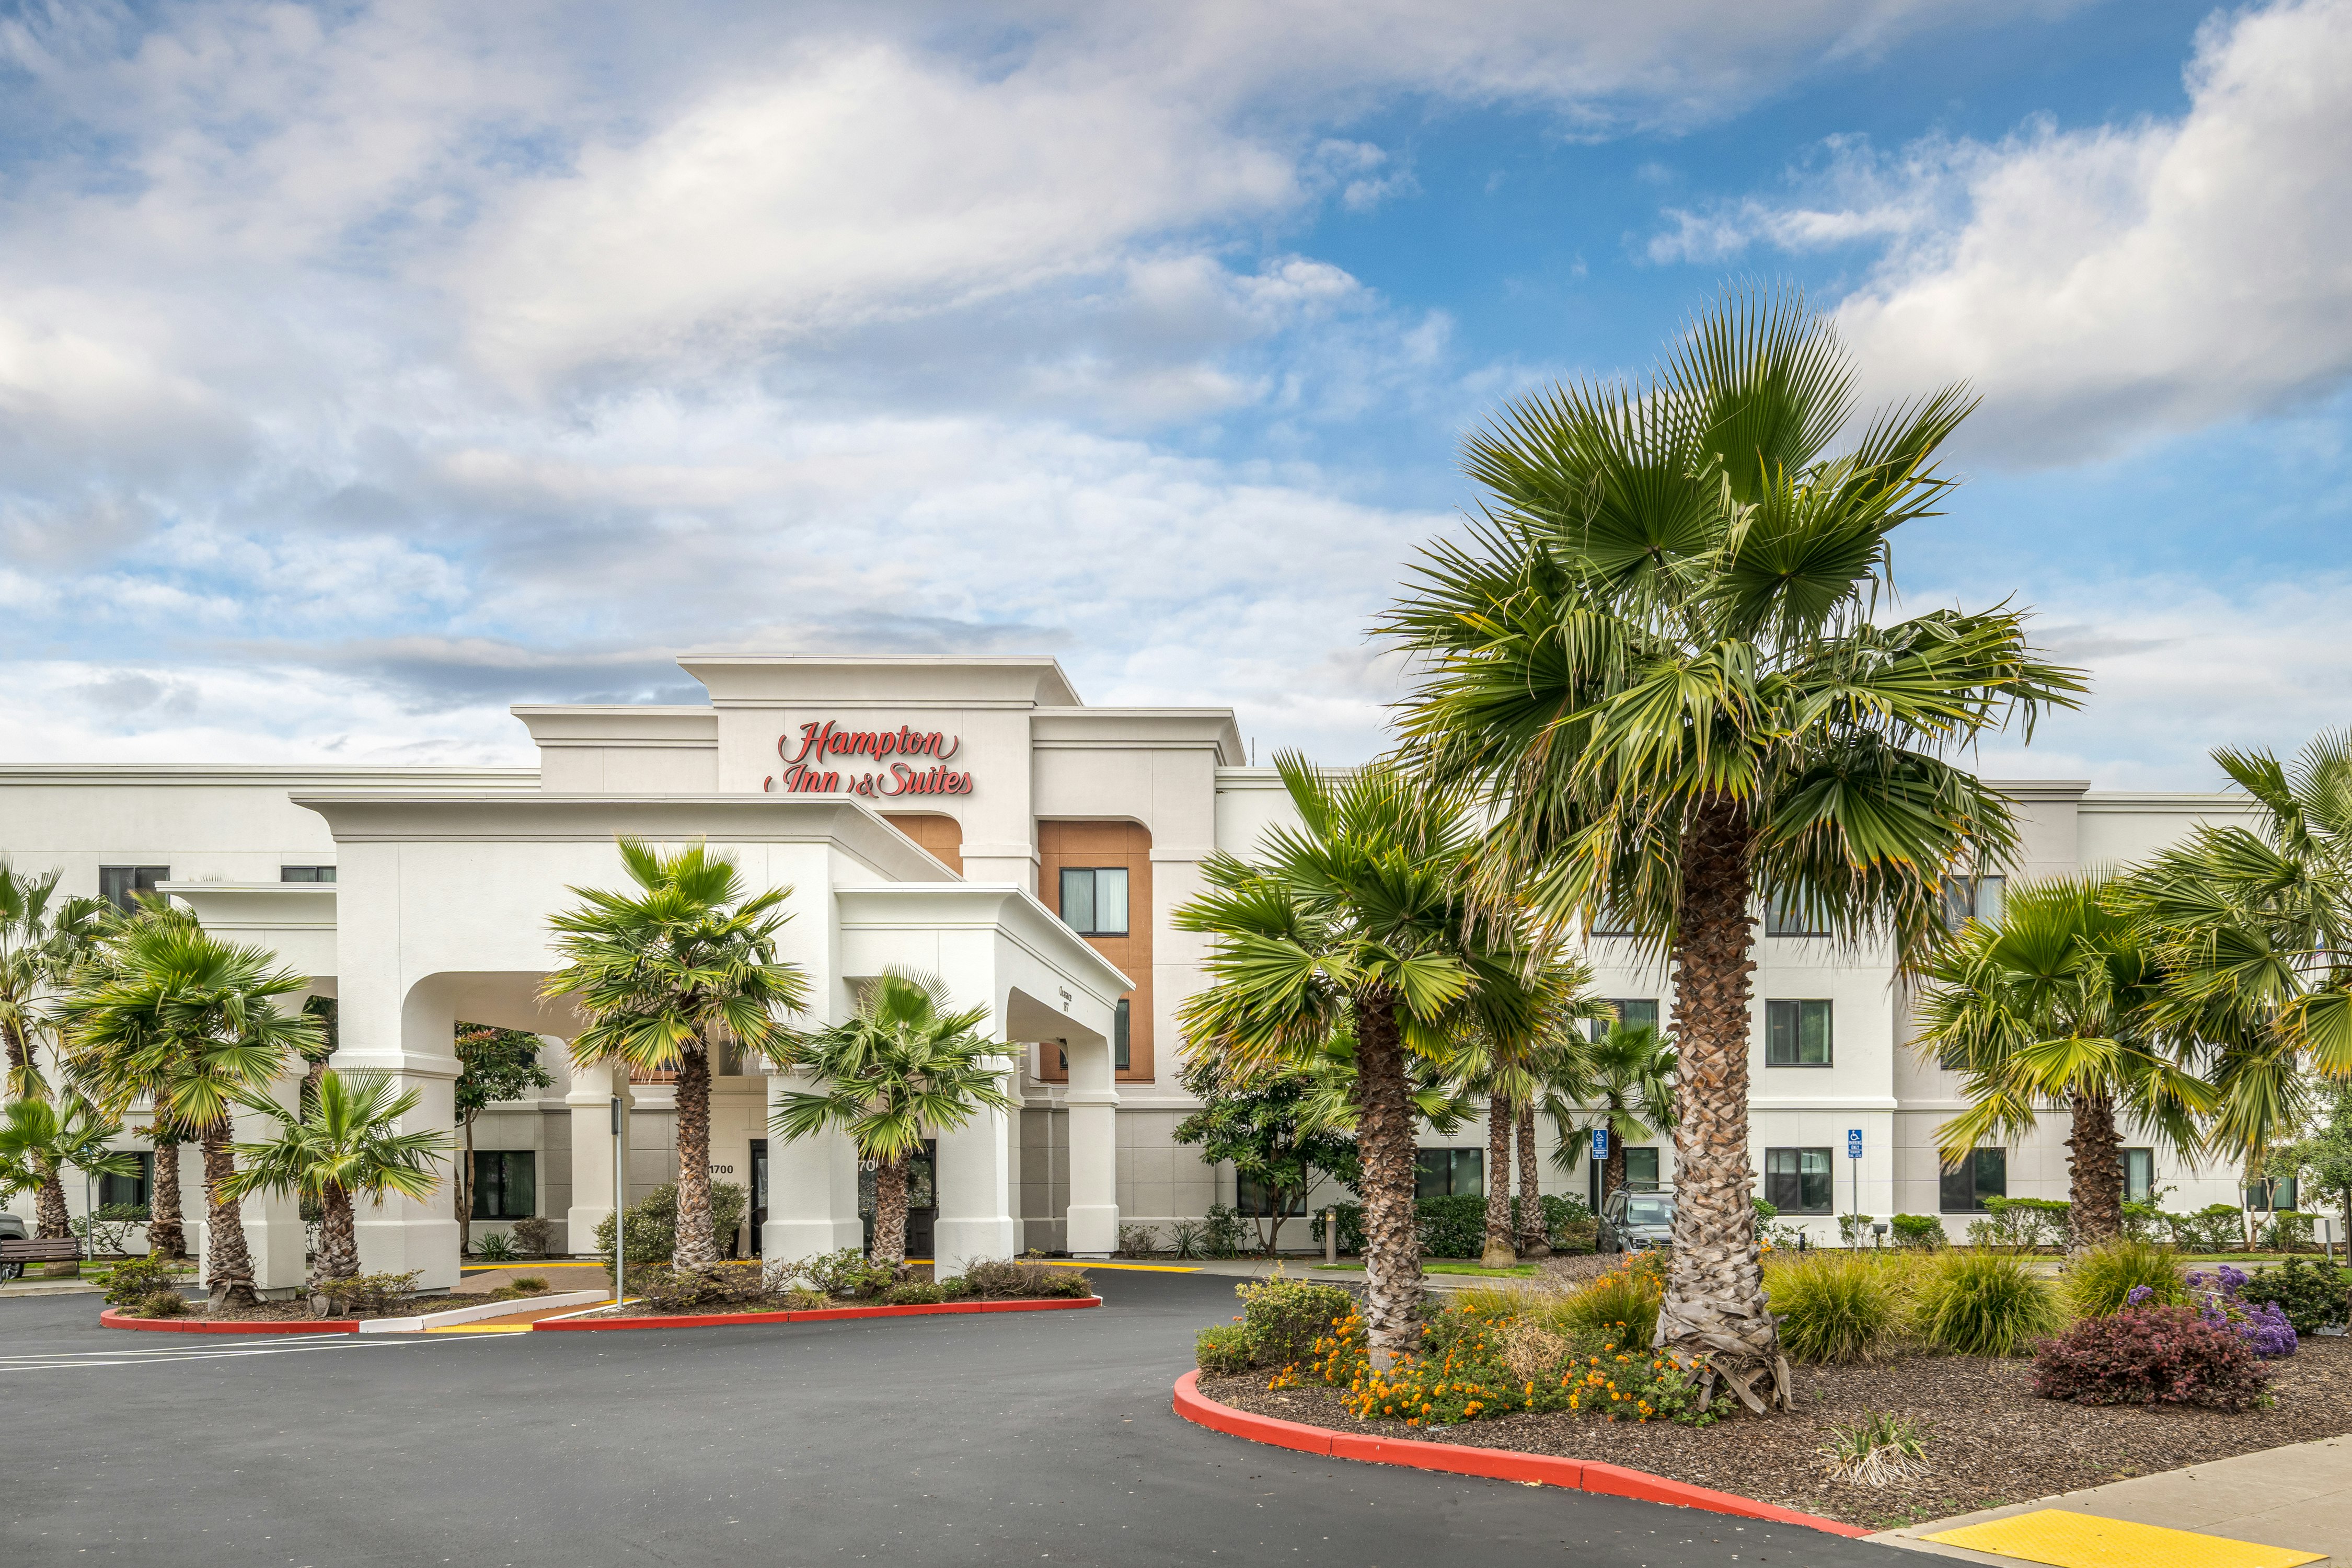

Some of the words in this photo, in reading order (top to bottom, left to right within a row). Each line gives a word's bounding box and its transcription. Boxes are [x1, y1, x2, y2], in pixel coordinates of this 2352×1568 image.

[778, 719, 959, 765] Hampton
[764, 763, 855, 793] Inn
[855, 773, 880, 799] &
[877, 762, 974, 797] Suites
[710, 1165, 734, 1174] 1700
